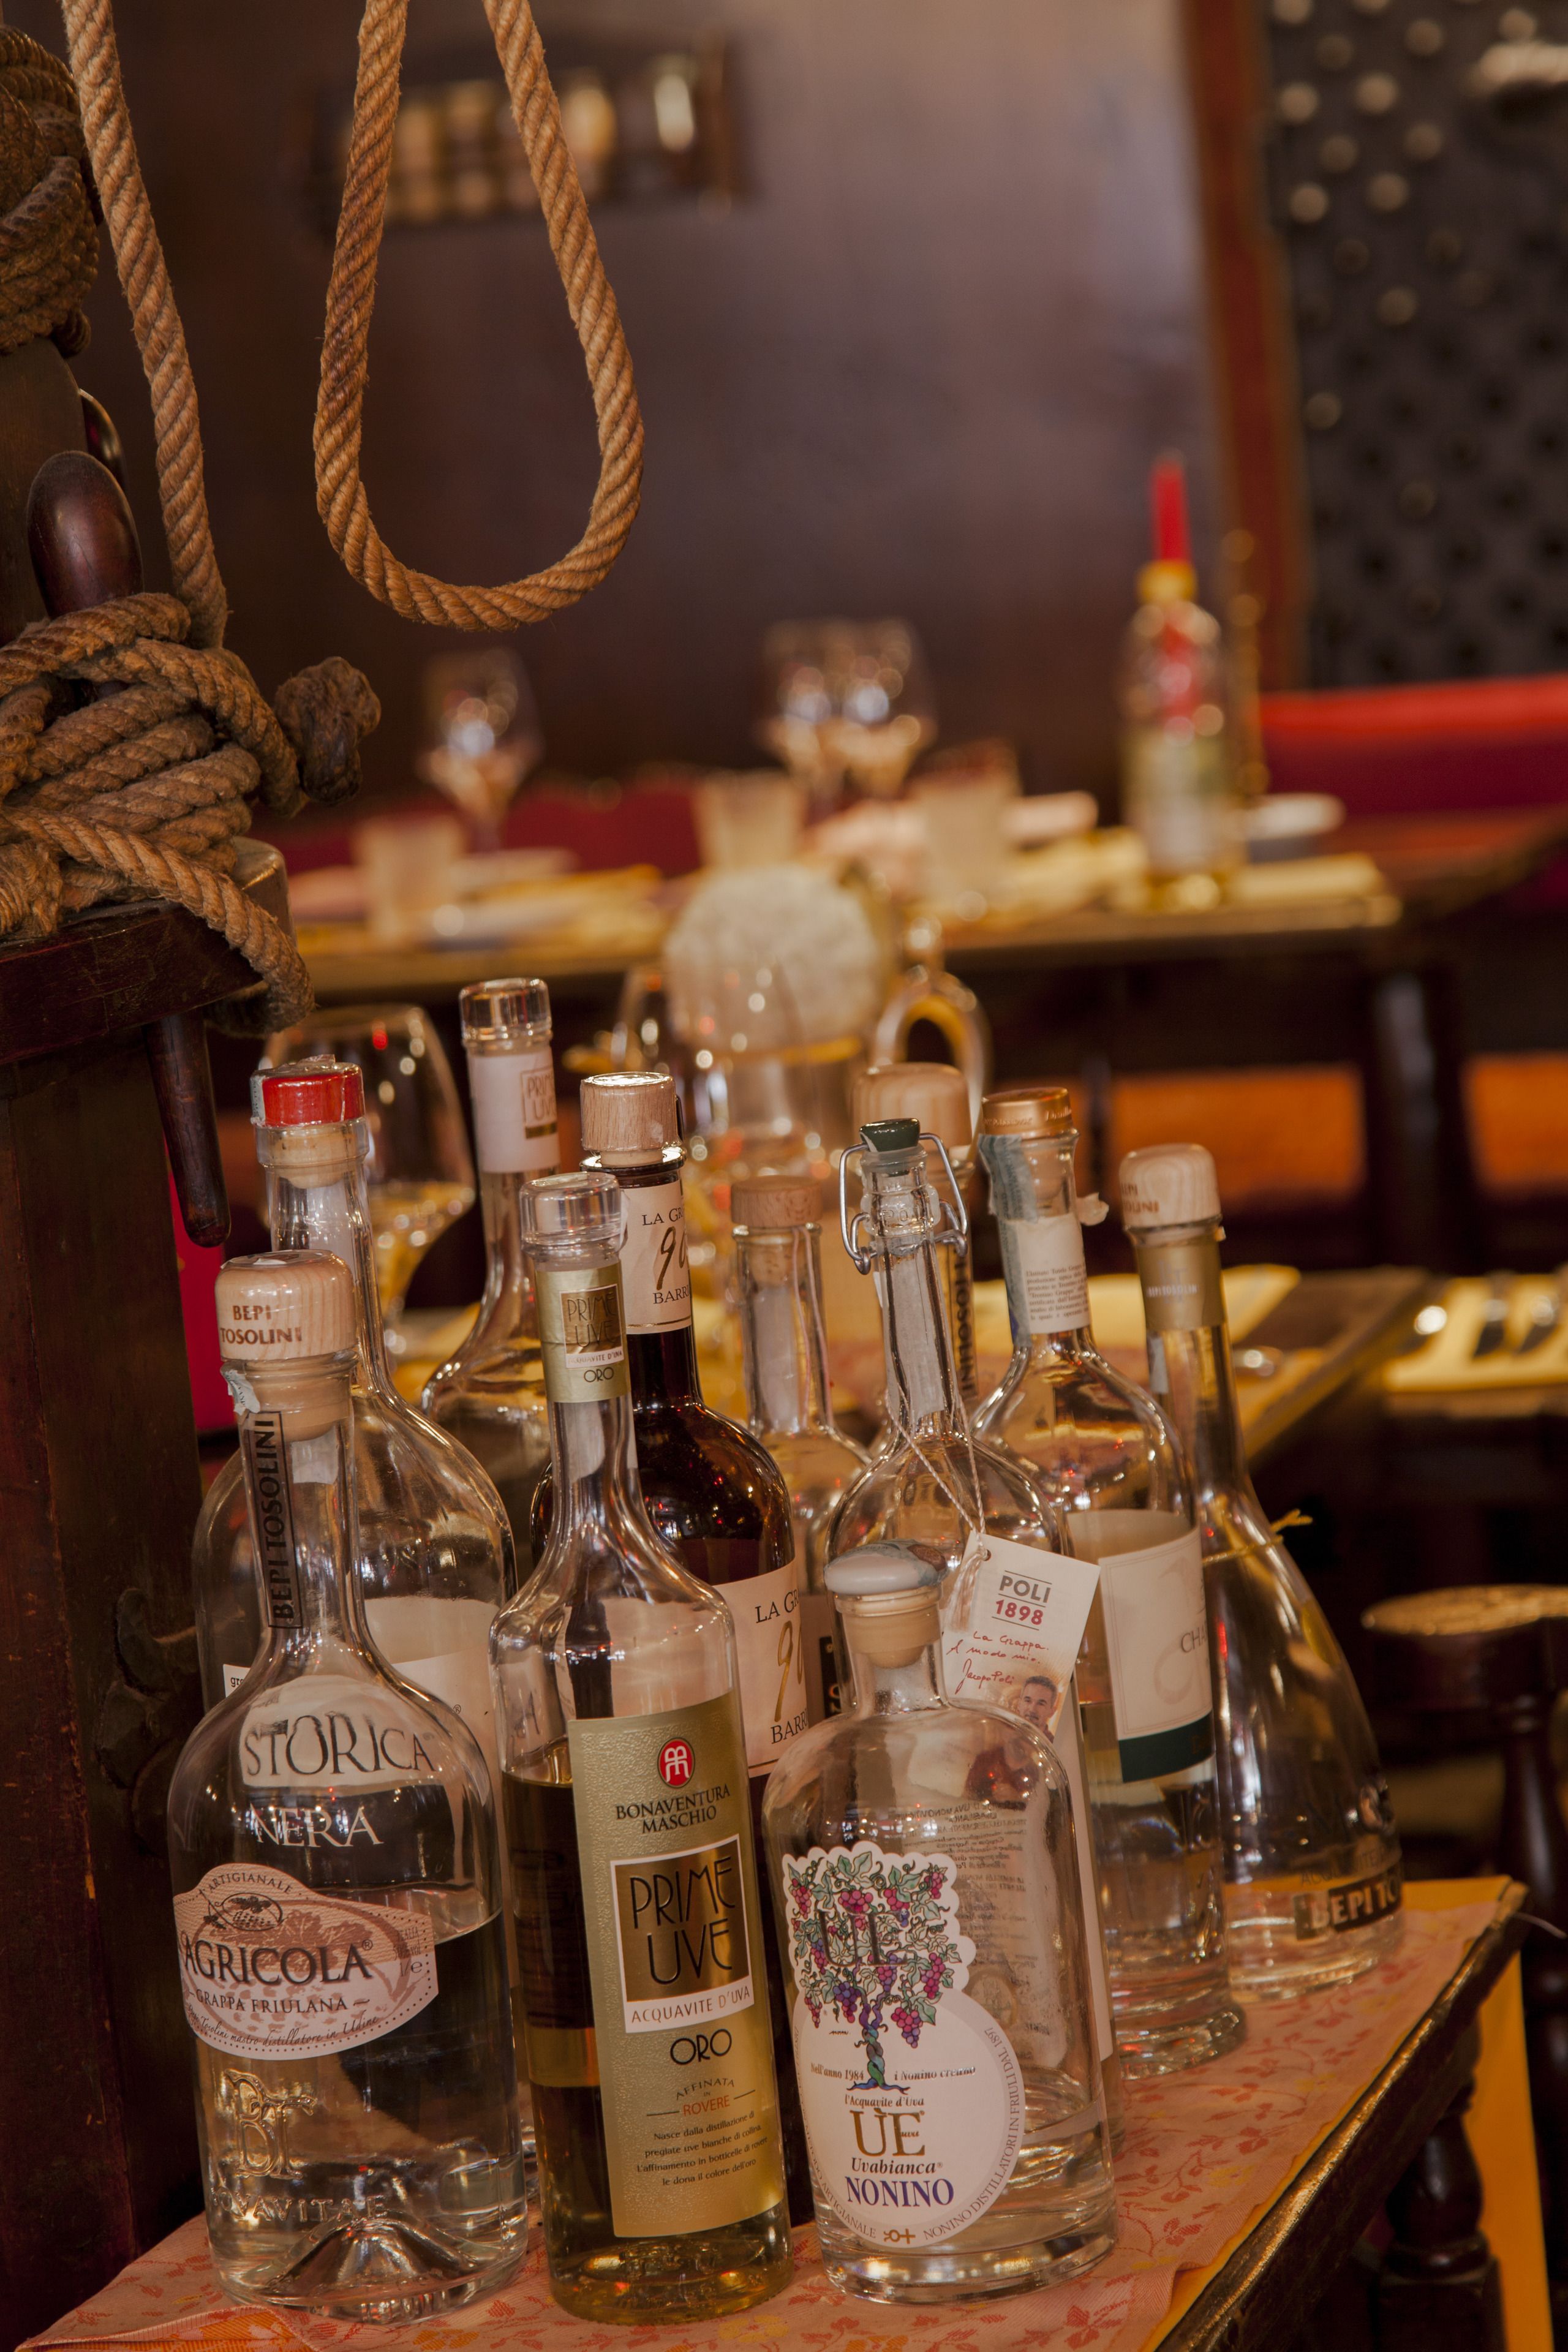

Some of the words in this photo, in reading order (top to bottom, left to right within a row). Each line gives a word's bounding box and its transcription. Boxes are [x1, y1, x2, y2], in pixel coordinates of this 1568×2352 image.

[642, 1213, 665, 1226] LA
[233, 1305, 271, 1320] BEPI
[567, 1292, 617, 1322] PRIME
[221, 1327, 302, 1344] TOSOLINI
[575, 1320, 619, 1348] UVE
[584, 1366, 614, 1383] ORO
[254, 1420, 287, 1551] TOSOLINI
[268, 1559, 295, 1621] BEPI
[999, 1575, 1051, 1603] POLI
[755, 1602, 780, 1623] LA
[995, 1599, 1044, 1625] 1898
[973, 1630, 993, 1642] La
[966, 1647, 1006, 1657] modo
[245, 1711, 436, 1775] STORICA
[616, 1784, 731, 1821] BONAVENTURA
[250, 1803, 385, 1847] NERA
[642, 1804, 717, 1834] MASCHIO
[208, 1873, 293, 1894] ARTIGIANALE
[630, 1856, 735, 1929] PRIME
[185, 1934, 372, 1985] AGRICOLA
[647, 1918, 733, 1985] UVE
[197, 1989, 246, 2011] GRAPPA
[252, 1997, 348, 2013] FRIULANA
[631, 1998, 713, 2023] ACQUAVITE
[718, 1986, 750, 2008] D'UVA
[201, 2016, 228, 2038] Tosolini
[230, 2034, 258, 2045] mastro
[263, 2028, 322, 2046] distillatore
[326, 2029, 337, 2038] in
[343, 2010, 377, 2034] Udine
[984, 2027, 1003, 2045] 1897
[670, 2029, 732, 2065] ORO
[998, 2046, 1014, 2072] DAL
[811, 2062, 842, 2078] Nell'anno
[845, 2069, 864, 2081] 1984
[901, 2070, 937, 2081] Nonino
[676, 2078, 735, 2101] AFFINATA
[845, 2094, 893, 2109] l'Acquavite
[1008, 2073, 1020, 2115] FRIULI
[683, 2095, 731, 2116] ROVERE
[654, 2131, 680, 2141] Nasce
[684, 2128, 703, 2136] dalla
[706, 2115, 748, 2133] distillazione
[750, 2110, 755, 2119] di
[1009, 2117, 1019, 2132] IN
[645, 2146, 681, 2158] pregiate
[702, 2136, 732, 2149] bianche
[734, 2132, 740, 2140] di
[742, 2124, 761, 2138] collina
[637, 2160, 696, 2173] L'affinamento
[709, 2148, 742, 2163] botticelle
[673, 2176, 695, 2185] dona
[706, 2167, 730, 2179] colore
[732, 2158, 756, 2173] dell'oro
[852, 2157, 936, 2174] Uvabianca
[970, 2135, 1018, 2213] DISTILLATORI
[845, 2176, 954, 2207] NONINO
[823, 2180, 876, 2239] ARTIGIANALE
[924, 2208, 972, 2240] NONINO
